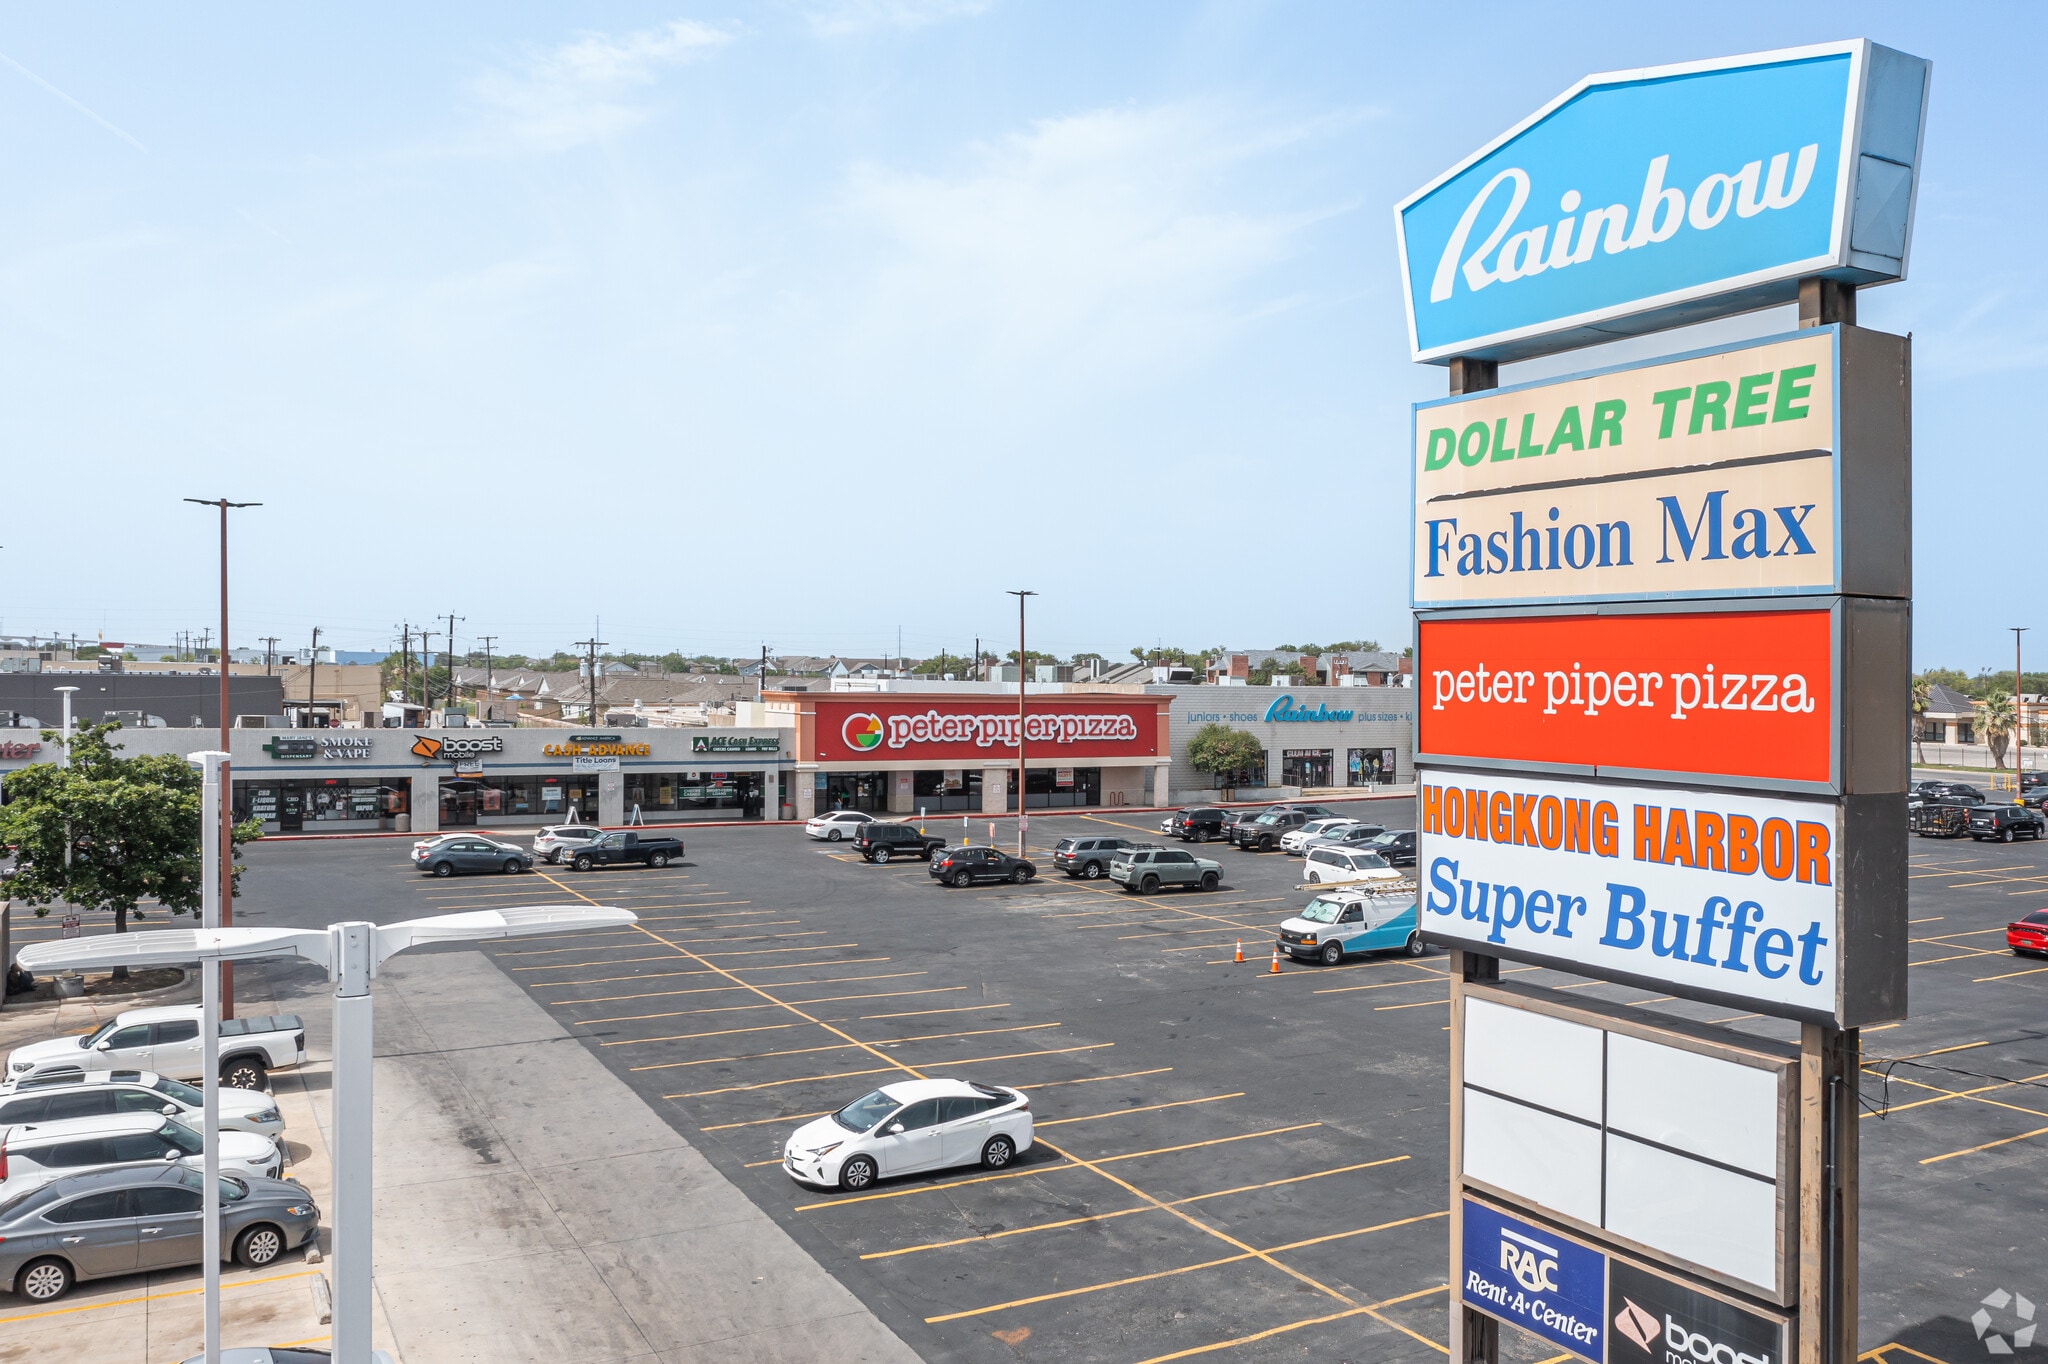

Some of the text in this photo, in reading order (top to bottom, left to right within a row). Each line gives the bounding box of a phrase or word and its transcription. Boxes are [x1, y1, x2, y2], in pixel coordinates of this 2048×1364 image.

[1429, 143, 1819, 303] Rainbow
[1424, 363, 1816, 472] DOLLAR TREE
[1424, 490, 1816, 578] Fashion Max
[1432, 661, 1815, 720] peter piper pizza
[1187, 711, 1258, 724] juniors shoes
[1264, 694, 1354, 723] Rainbow
[1358, 711, 1376, 723] plus
[1378, 711, 1398, 722] sizes
[890, 713, 1135, 745] peter piper pizza
[0, 740, 41, 759] ter
[321, 736, 373, 747] SMOKE
[323, 748, 371, 759] & VAPE
[443, 737, 503, 752] boost
[543, 743, 651, 756] CASH ADVANCE
[711, 737, 726, 746] ACE
[575, 756, 617, 764] Title Loans
[1423, 784, 1833, 887] HONGKONG HARBOR
[1427, 856, 1828, 986] Super Buffet
[1500, 1238, 1559, 1293] RAC
